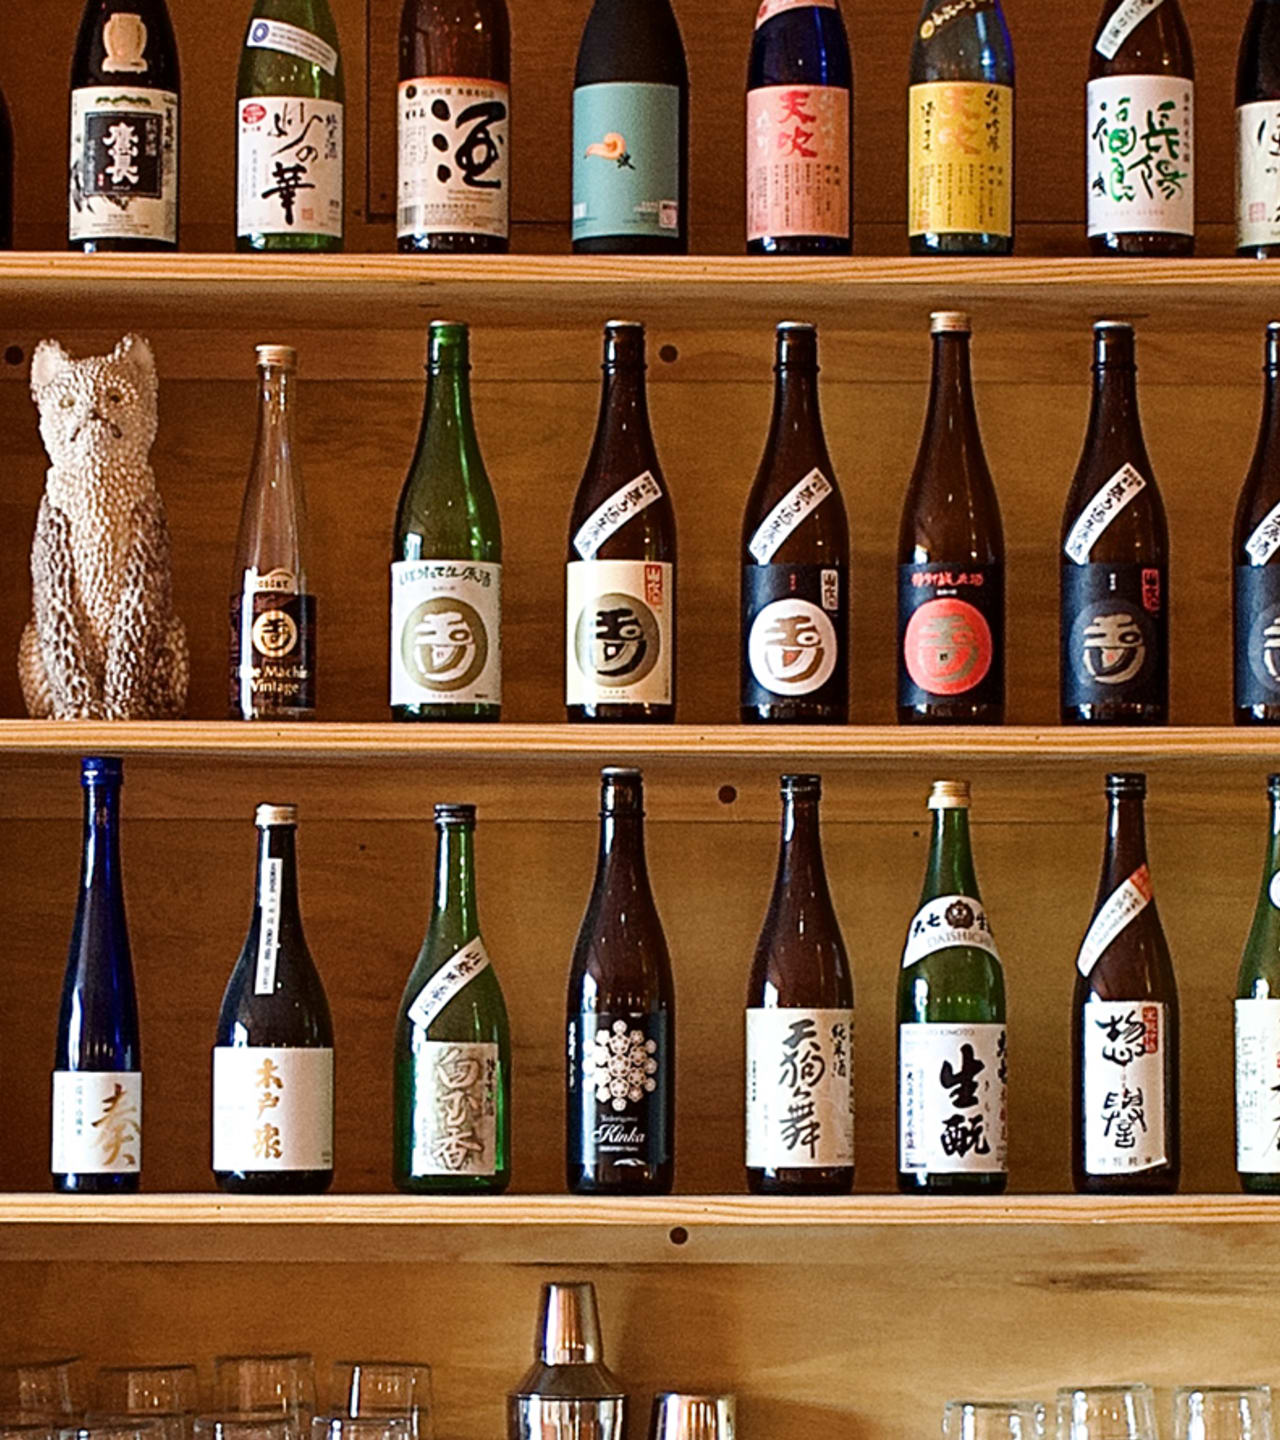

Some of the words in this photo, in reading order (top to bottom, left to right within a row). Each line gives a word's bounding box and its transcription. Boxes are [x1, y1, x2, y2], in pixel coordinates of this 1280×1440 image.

[779, 89, 819, 159] 天吹
[251, 678, 300, 696] Vintage
[830, 1022, 848, 1078] 純米酒
[591, 1123, 646, 1144] Kinka
